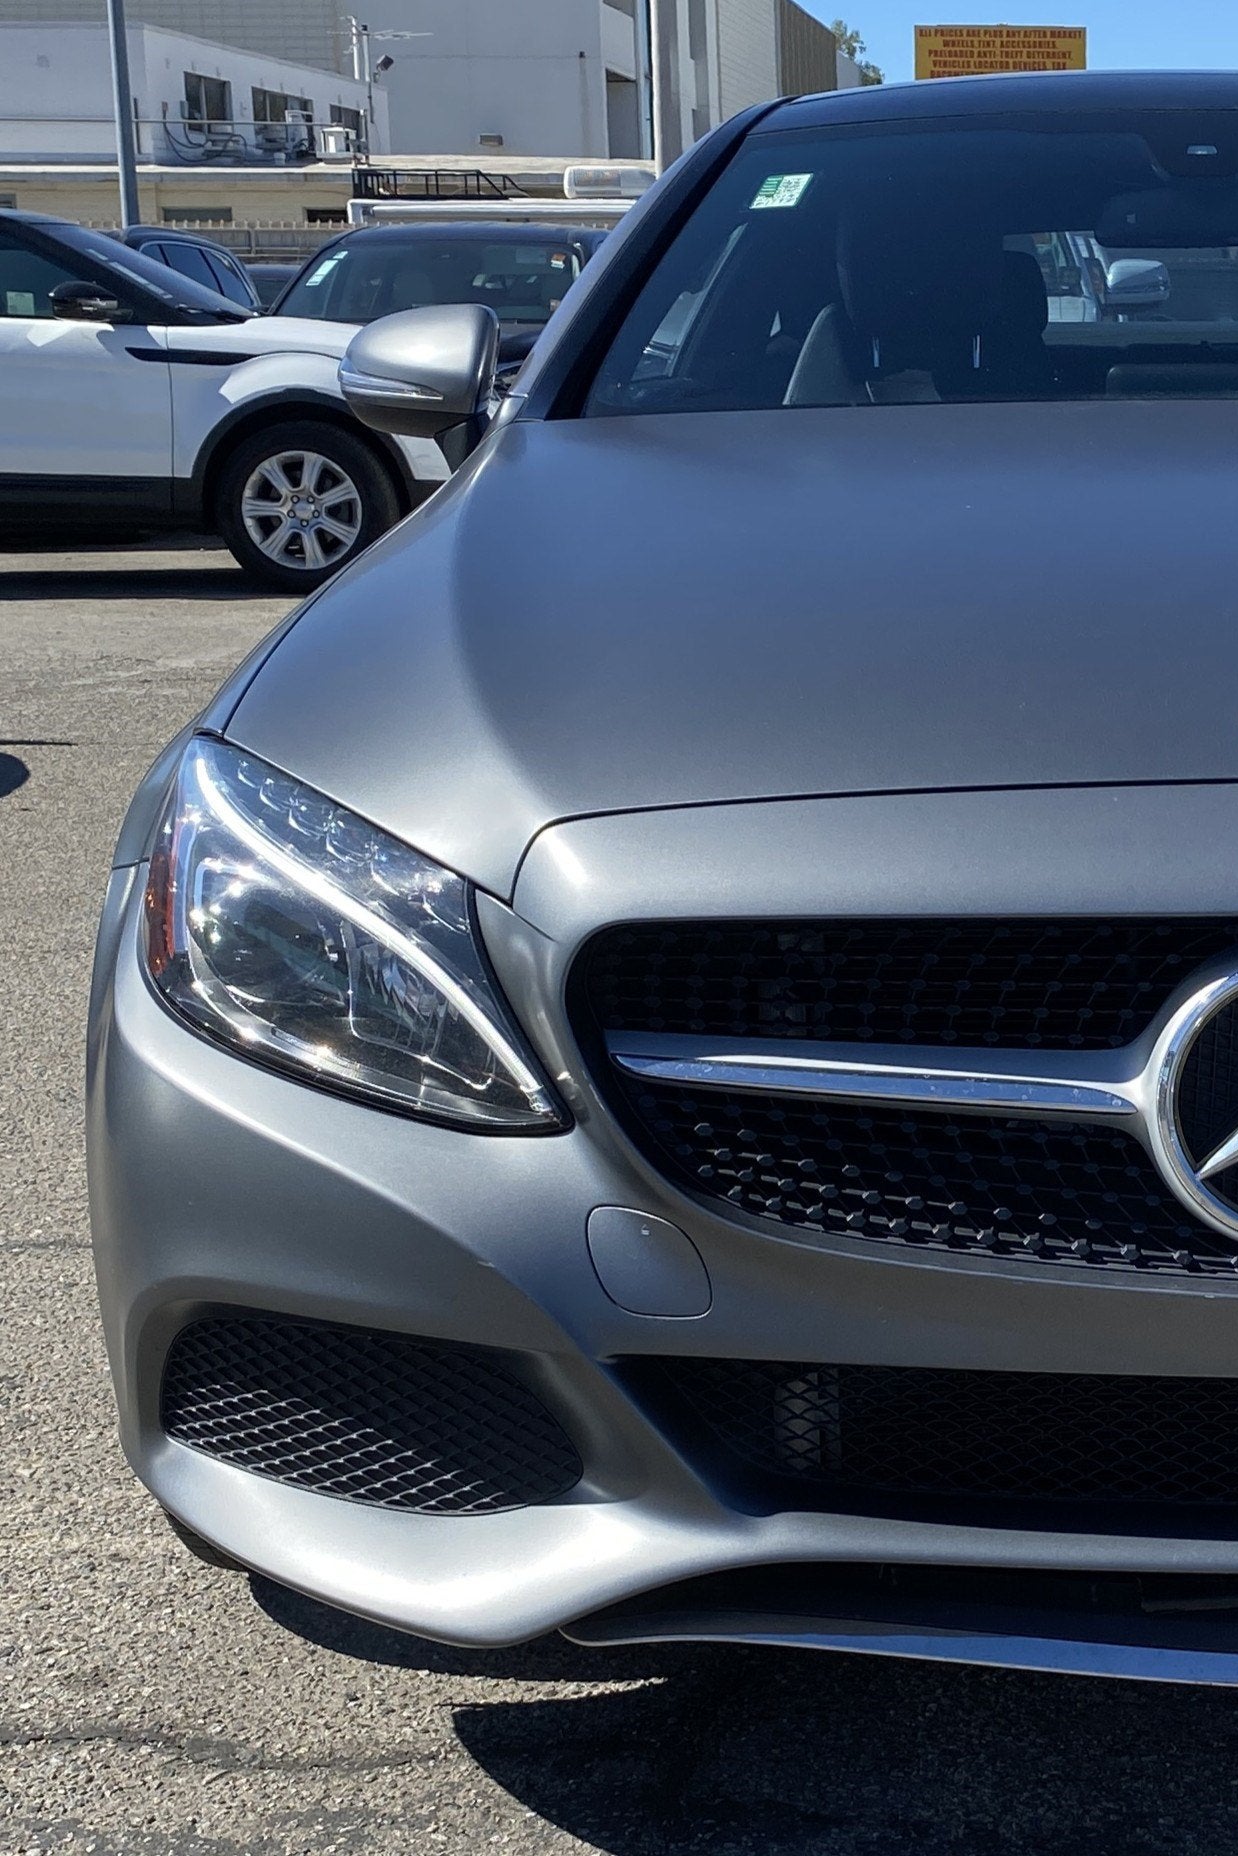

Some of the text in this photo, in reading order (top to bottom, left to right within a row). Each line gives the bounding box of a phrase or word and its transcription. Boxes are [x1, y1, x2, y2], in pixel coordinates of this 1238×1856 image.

[918, 29, 1082, 39] ALL PRICES ARE PLUS ANY AFTER MARKET
[928, 49, 975, 58] PRELOADED
[932, 59, 971, 69] VEHICLES
[973, 60, 1010, 70] LOCATOR
[1051, 61, 1067, 70] TAX
